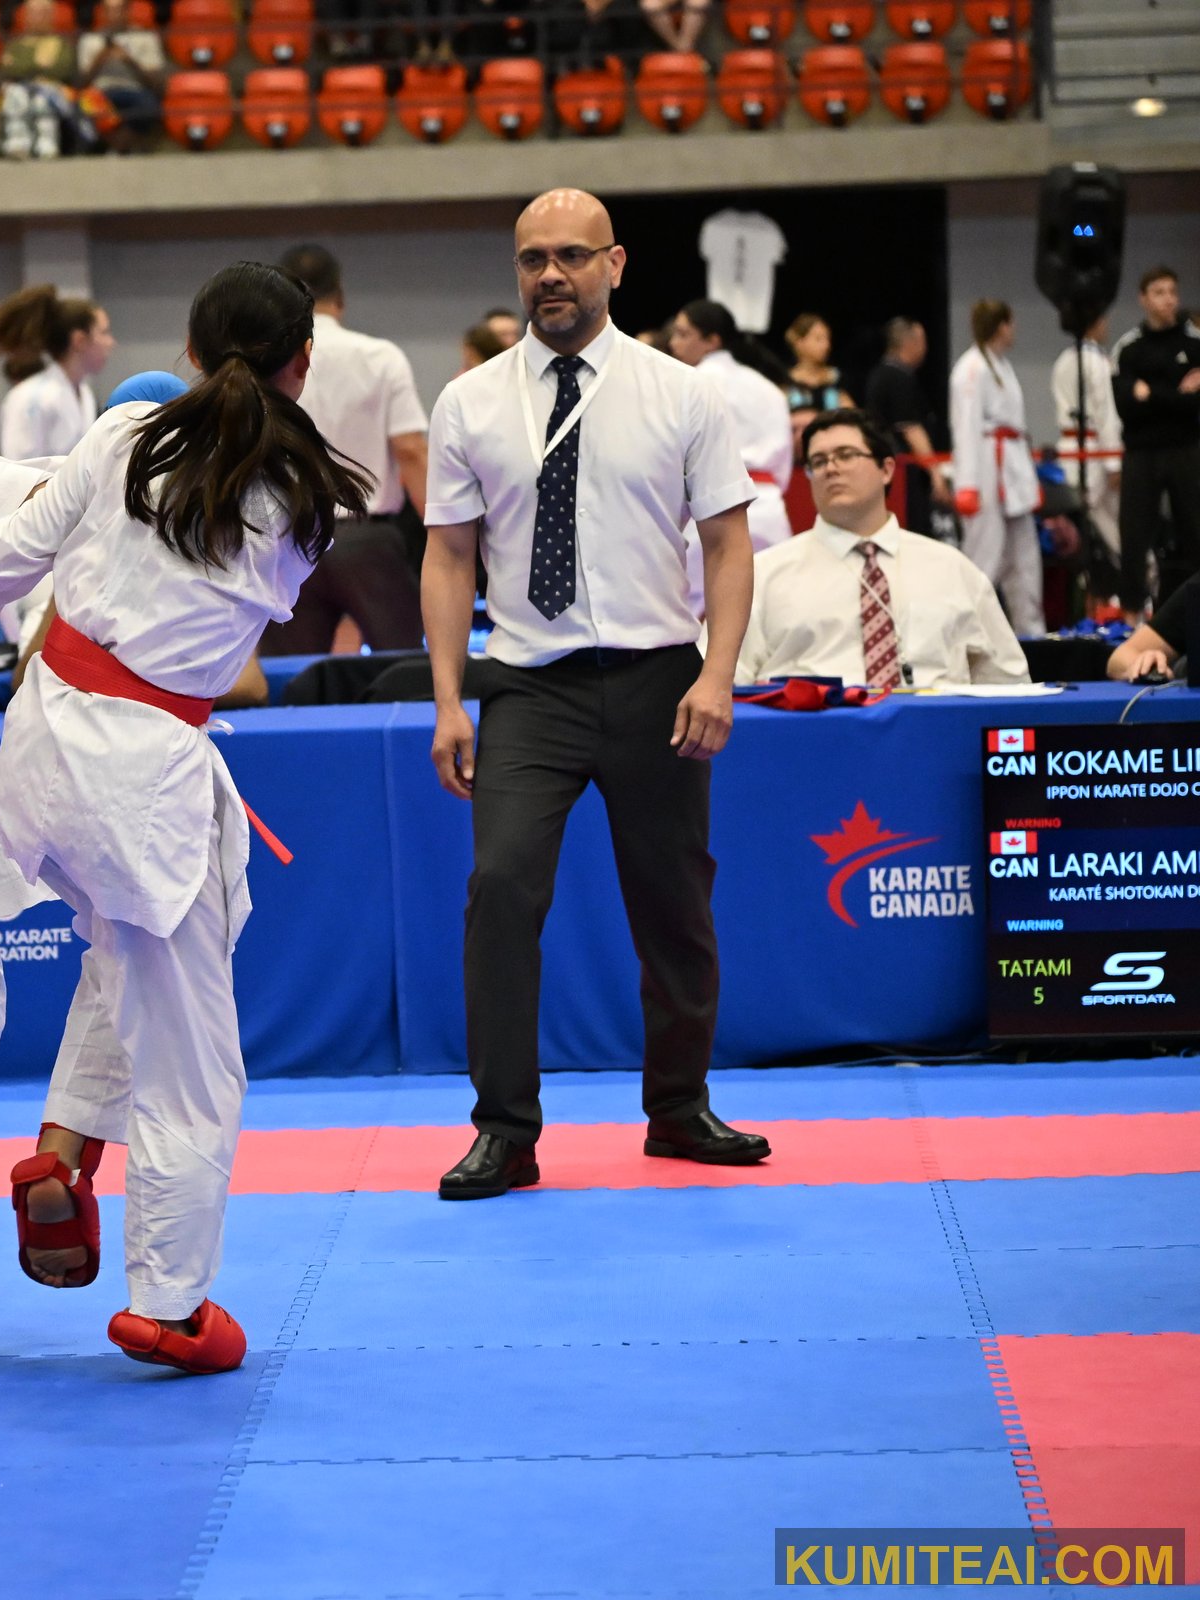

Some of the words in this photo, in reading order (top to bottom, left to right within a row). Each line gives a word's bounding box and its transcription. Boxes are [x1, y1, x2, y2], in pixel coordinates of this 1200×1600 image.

[987, 755, 1036, 776] CAN
[1047, 749, 1164, 775] KOKAME
[1046, 785, 1090, 799] IPPON
[1094, 783, 1146, 798] KARATE
[1150, 782, 1189, 797] DOJO
[1005, 818, 1061, 829] WARNING
[989, 857, 1038, 878] CAN
[1050, 852, 1143, 877] LARAKI
[1151, 850, 1200, 875] AM
[869, 865, 971, 892] KARATE
[1049, 884, 1102, 901] KARATÉ
[1105, 885, 1184, 900] SHOTOKAN
[1187, 884, 1200, 898] D
[870, 892, 974, 918] CANADA
[1007, 919, 1064, 931] WARNING
[5, 928, 72, 945] KARATE
[0, 945, 59, 961] RATION
[998, 959, 1071, 977] TATAMI
[1033, 987, 1044, 1005] 5
[1081, 993, 1176, 1006] SPORTDATA
